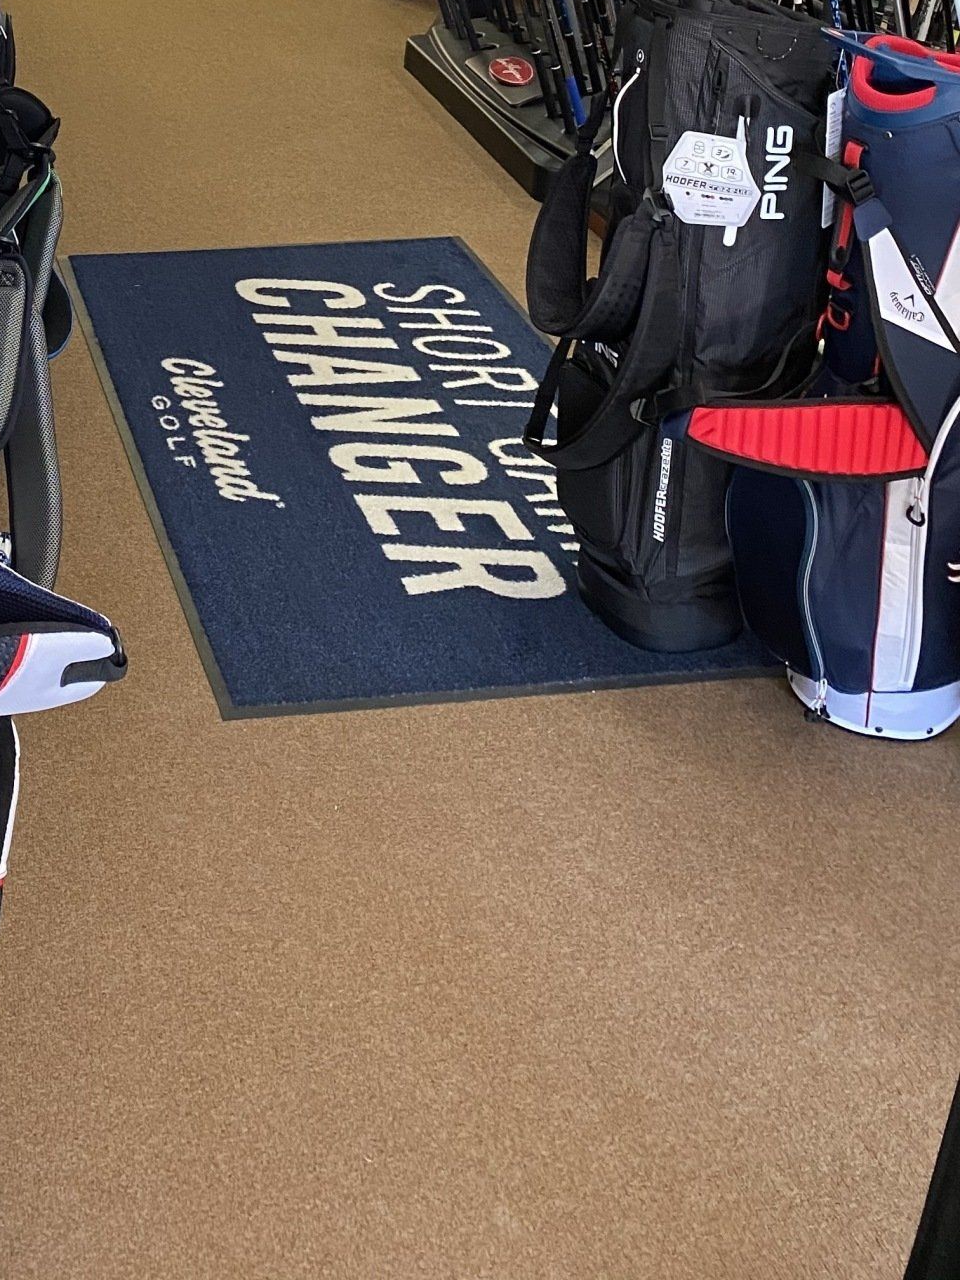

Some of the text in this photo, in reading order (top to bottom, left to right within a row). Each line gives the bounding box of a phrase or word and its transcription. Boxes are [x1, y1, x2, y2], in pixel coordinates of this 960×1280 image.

[665, 174, 708, 190] HOOFER
[760, 125, 794, 220] PING
[890, 291, 925, 322] Callaway
[151, 395, 196, 469] GOLF
[160, 356, 285, 509] Cleveland
[234, 277, 567, 600] CHANGER
